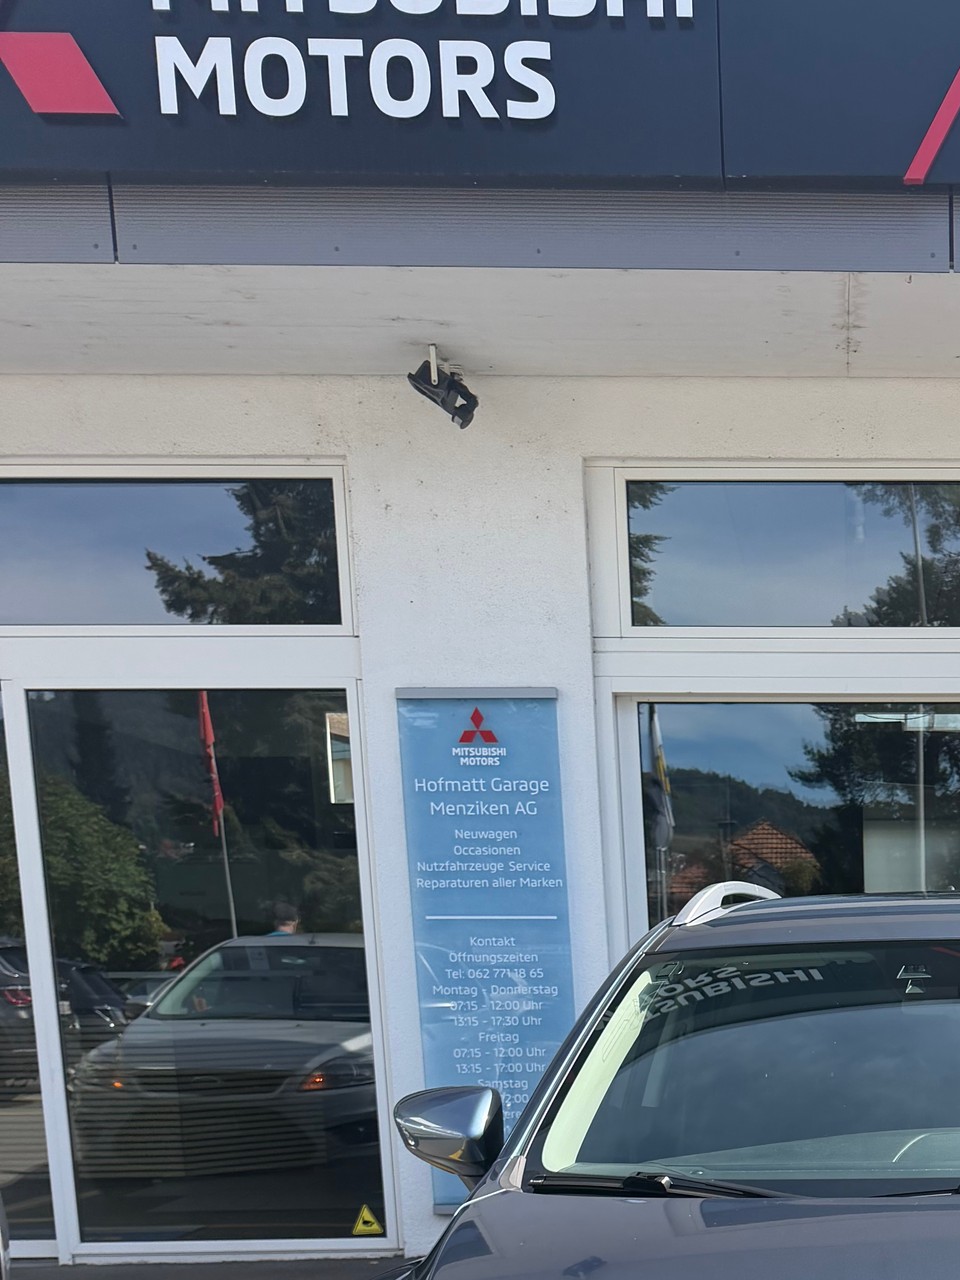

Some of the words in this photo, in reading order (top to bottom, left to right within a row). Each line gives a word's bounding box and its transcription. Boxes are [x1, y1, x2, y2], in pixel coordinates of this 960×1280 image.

[153, 35, 556, 120] MOTORS
[452, 747, 506, 756] MITSUBISHI
[460, 757, 500, 766] MOTORS
[414, 778, 486, 792] Hofmatt
[491, 778, 550, 794] Garage
[430, 801, 509, 815] Menziken
[515, 802, 537, 815] AG
[454, 828, 517, 841] Neuwagen
[453, 845, 521, 856] Occasionen
[417, 861, 504, 873] Nutzfahrzeuge
[508, 861, 550, 871] Service
[416, 878, 489, 890] Reparaturen
[492, 878, 516, 887] aller
[520, 878, 563, 887] Marken
[469, 936, 516, 947] Kontakt
[445, 968, 465, 979] Tel:
[467, 969, 490, 979] 062
[529, 968, 544, 978] 65
[432, 985, 478, 996] Montag
[490, 985, 558, 996] Donnerstag
[490, 1001, 520, 1010] 12:00
[522, 1000, 543, 1010] Uhr
[491, 1016, 519, 1026] 17:30
[522, 1016, 542, 1026] Uhr
[478, 1032, 519, 1044] Freitag
[453, 1048, 481, 1058] 07:15
[494, 1047, 523, 1057] 12:00
[525, 1047, 546, 1057] Uhr
[456, 1063, 482, 1073] 13:15
[525, 1063, 546, 1073] Uhr
[477, 1079, 529, 1090] Samstag
